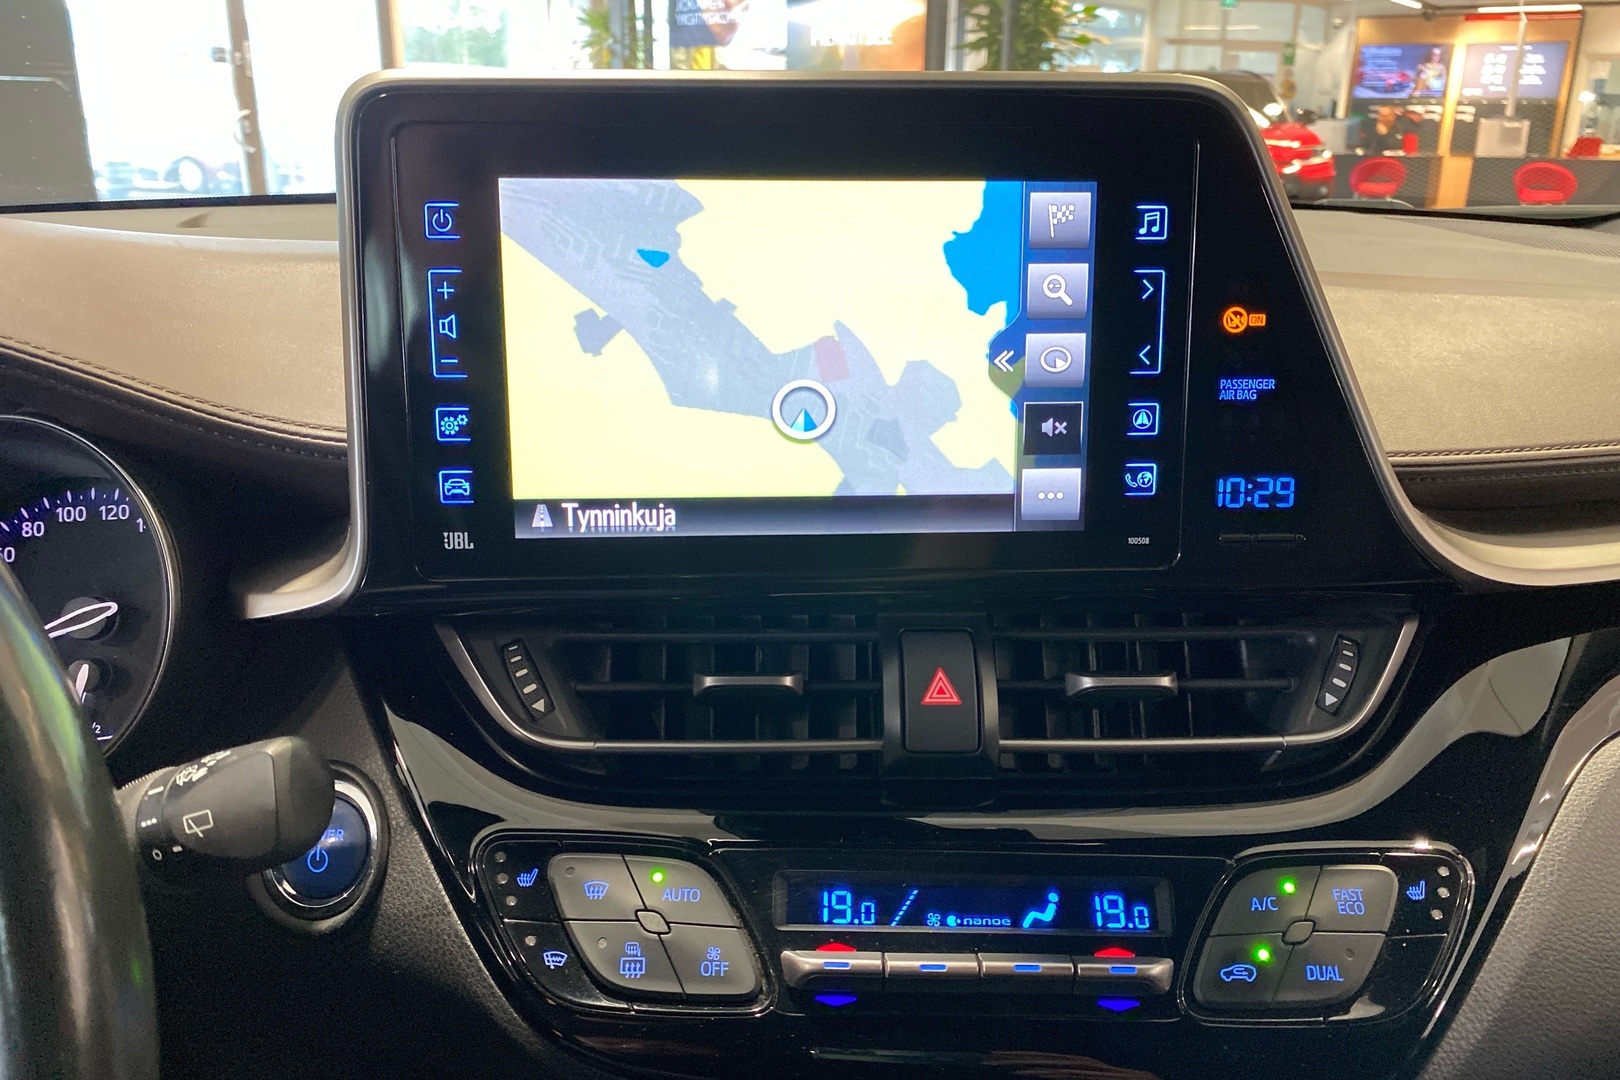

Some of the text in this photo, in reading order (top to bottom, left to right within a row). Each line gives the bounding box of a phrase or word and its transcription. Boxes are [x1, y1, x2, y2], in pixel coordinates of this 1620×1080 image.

[1250, 315, 1265, 325] ON
[1219, 378, 1276, 391] PASSENGER
[1219, 390, 1257, 400] AIR BAG
[1217, 477, 1295, 508] 10:29
[57, 505, 87, 522] 100
[101, 504, 130, 521] 120
[562, 502, 677, 531] Tynninkuja
[22, 521, 45, 538] 80
[443, 531, 474, 549] JBL
[1128, 537, 1149, 546] 100508
[662, 888, 701, 903] AUTO
[1333, 888, 1363, 901] FAST
[822, 890, 875, 925] 19.0
[1094, 893, 1149, 929] 19.0
[1251, 897, 1279, 912] A/C
[1338, 901, 1366, 916] ECO
[963, 916, 1011, 927] nanoe
[700, 962, 730, 976] OFF
[1306, 965, 1344, 981] DUAL
